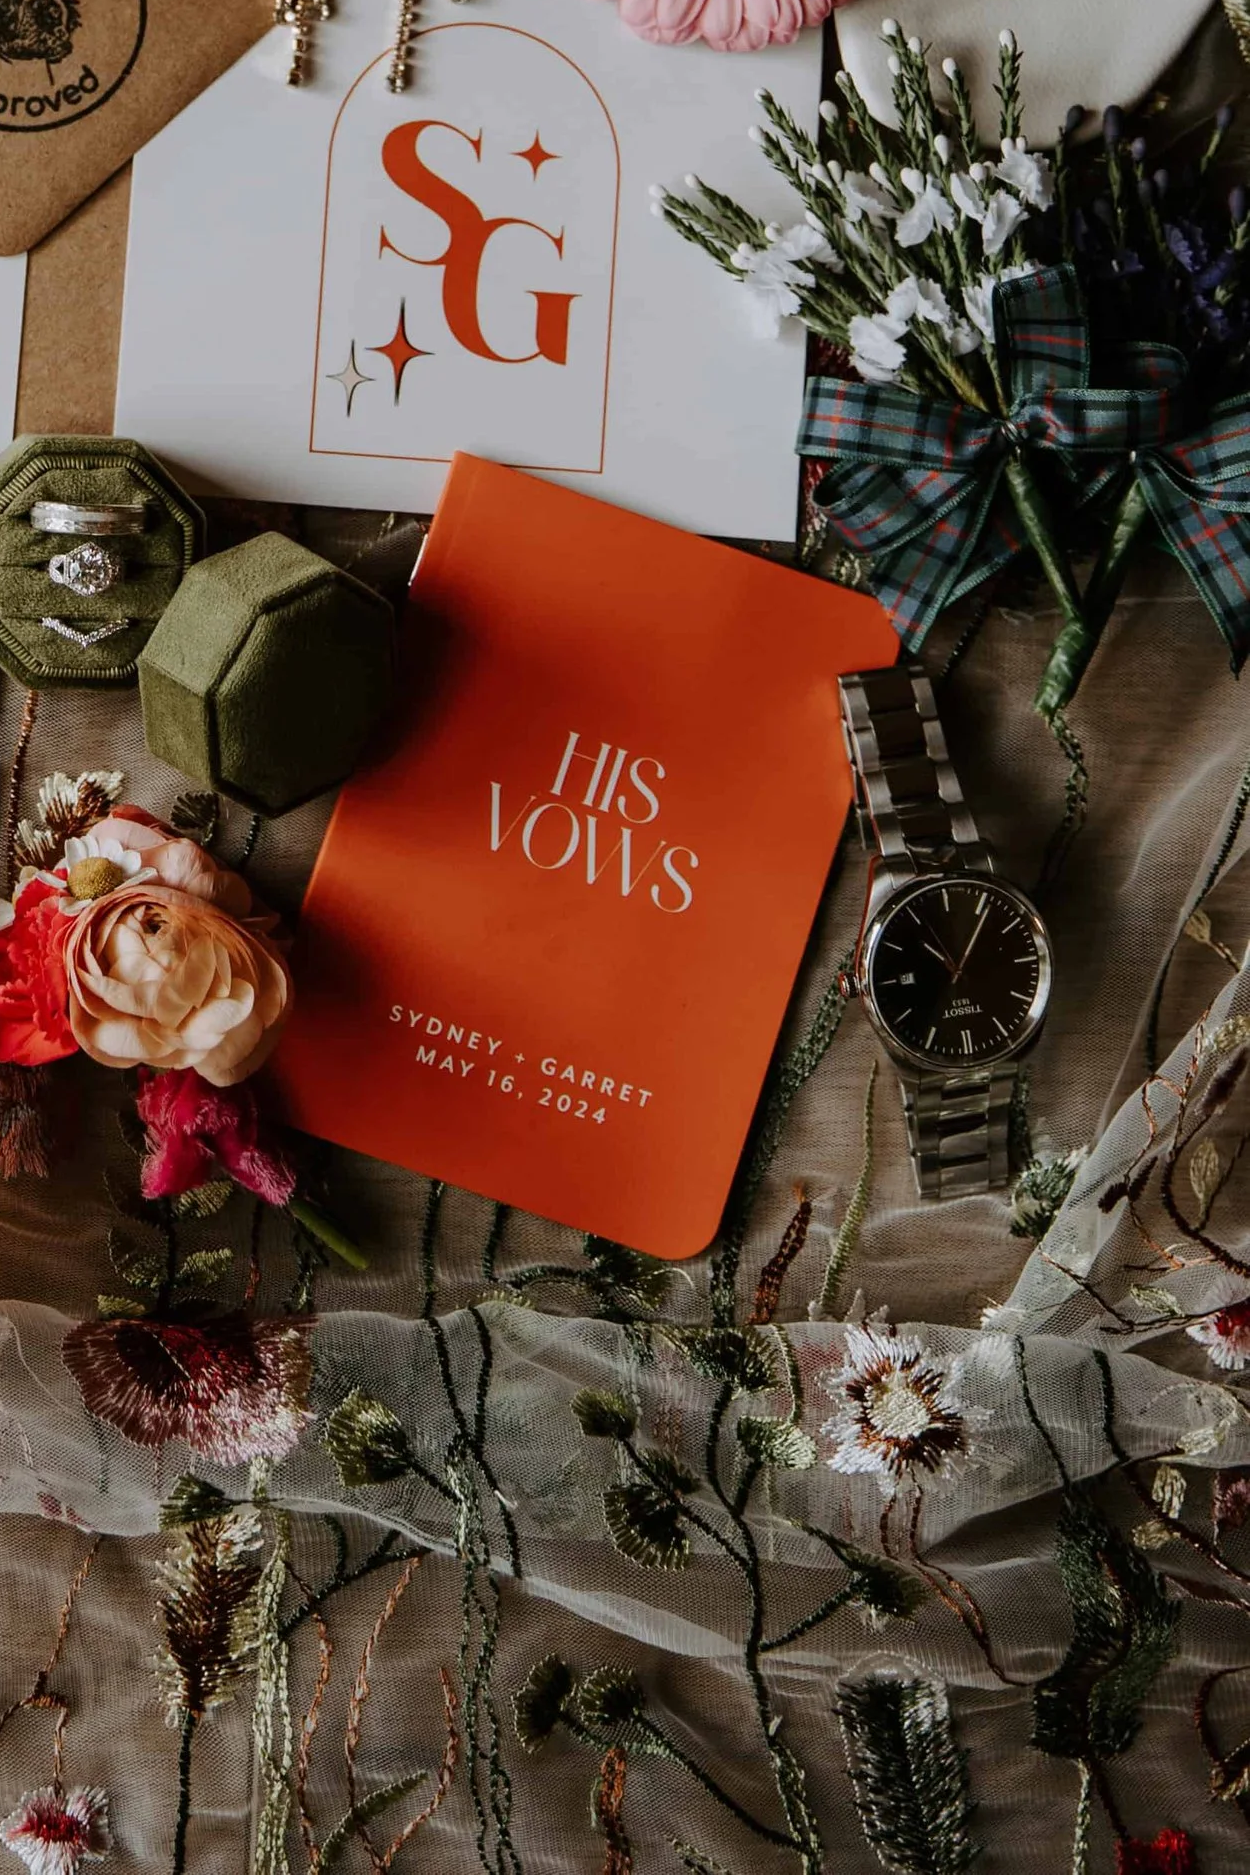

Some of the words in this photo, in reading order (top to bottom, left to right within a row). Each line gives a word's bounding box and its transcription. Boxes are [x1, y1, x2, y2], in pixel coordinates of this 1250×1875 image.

[549, 730, 666, 824] HIS
[489, 780, 700, 914] VOWS
[388, 1004, 502, 1057] SYDNEY
[540, 1057, 654, 1109] GARRET
[941, 1003, 983, 1019] TISSOT
[415, 1045, 475, 1078] MAY
[487, 1070, 524, 1099] 16,
[538, 1088, 608, 1125] 2024
